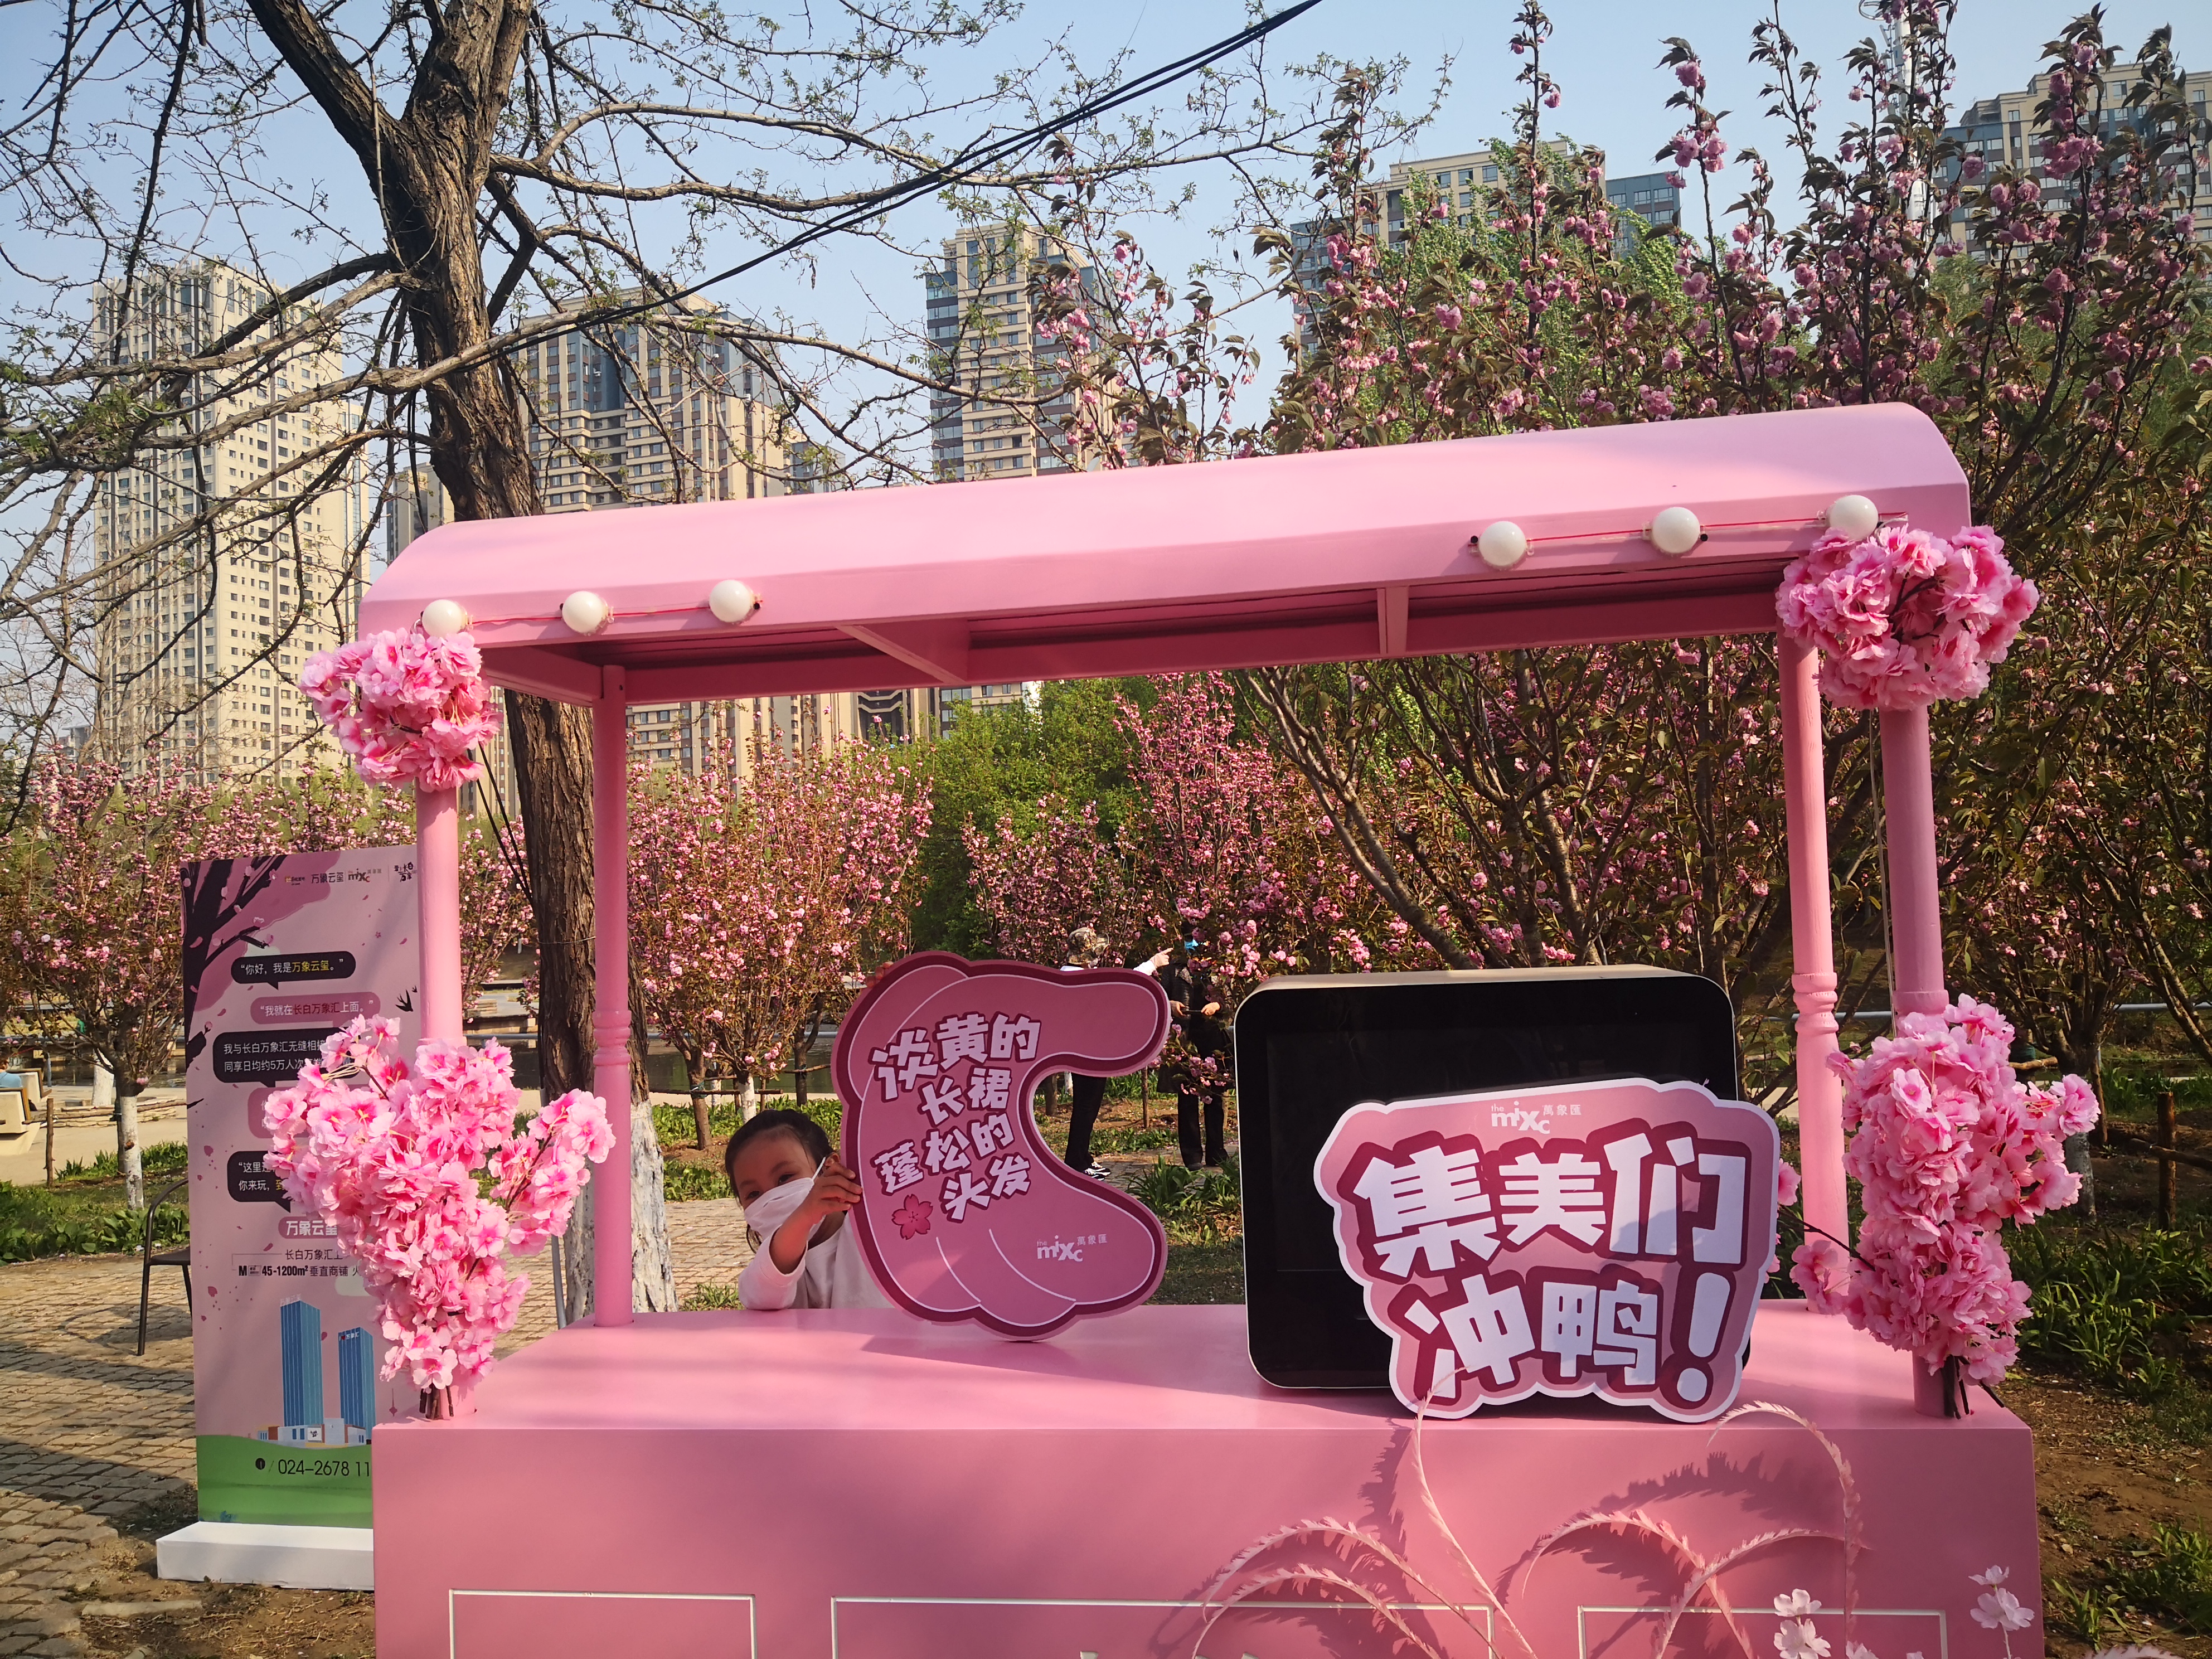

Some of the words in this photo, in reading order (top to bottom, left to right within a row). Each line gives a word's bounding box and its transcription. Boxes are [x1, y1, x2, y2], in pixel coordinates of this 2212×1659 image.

[311, 872, 344, 884] 万象云玺
[224, 1058, 323, 1073] 同享日均约5万人次
[872, 1014, 1040, 1100] 淡黄的
[922, 1068, 1011, 1124] 长裙
[1491, 1103, 1504, 1112] the
[875, 1114, 1013, 1194] 蓬松的
[944, 1156, 1030, 1220] 头发
[1353, 1132, 1746, 1278] 集美们
[239, 1266, 247, 1276] M
[310, 1265, 348, 1277] 垂直商铺
[1404, 1272, 1731, 1402] 冲鸭！
[278, 1459, 350, 1476] 024-2678
[356, 1462, 370, 1477] 11
